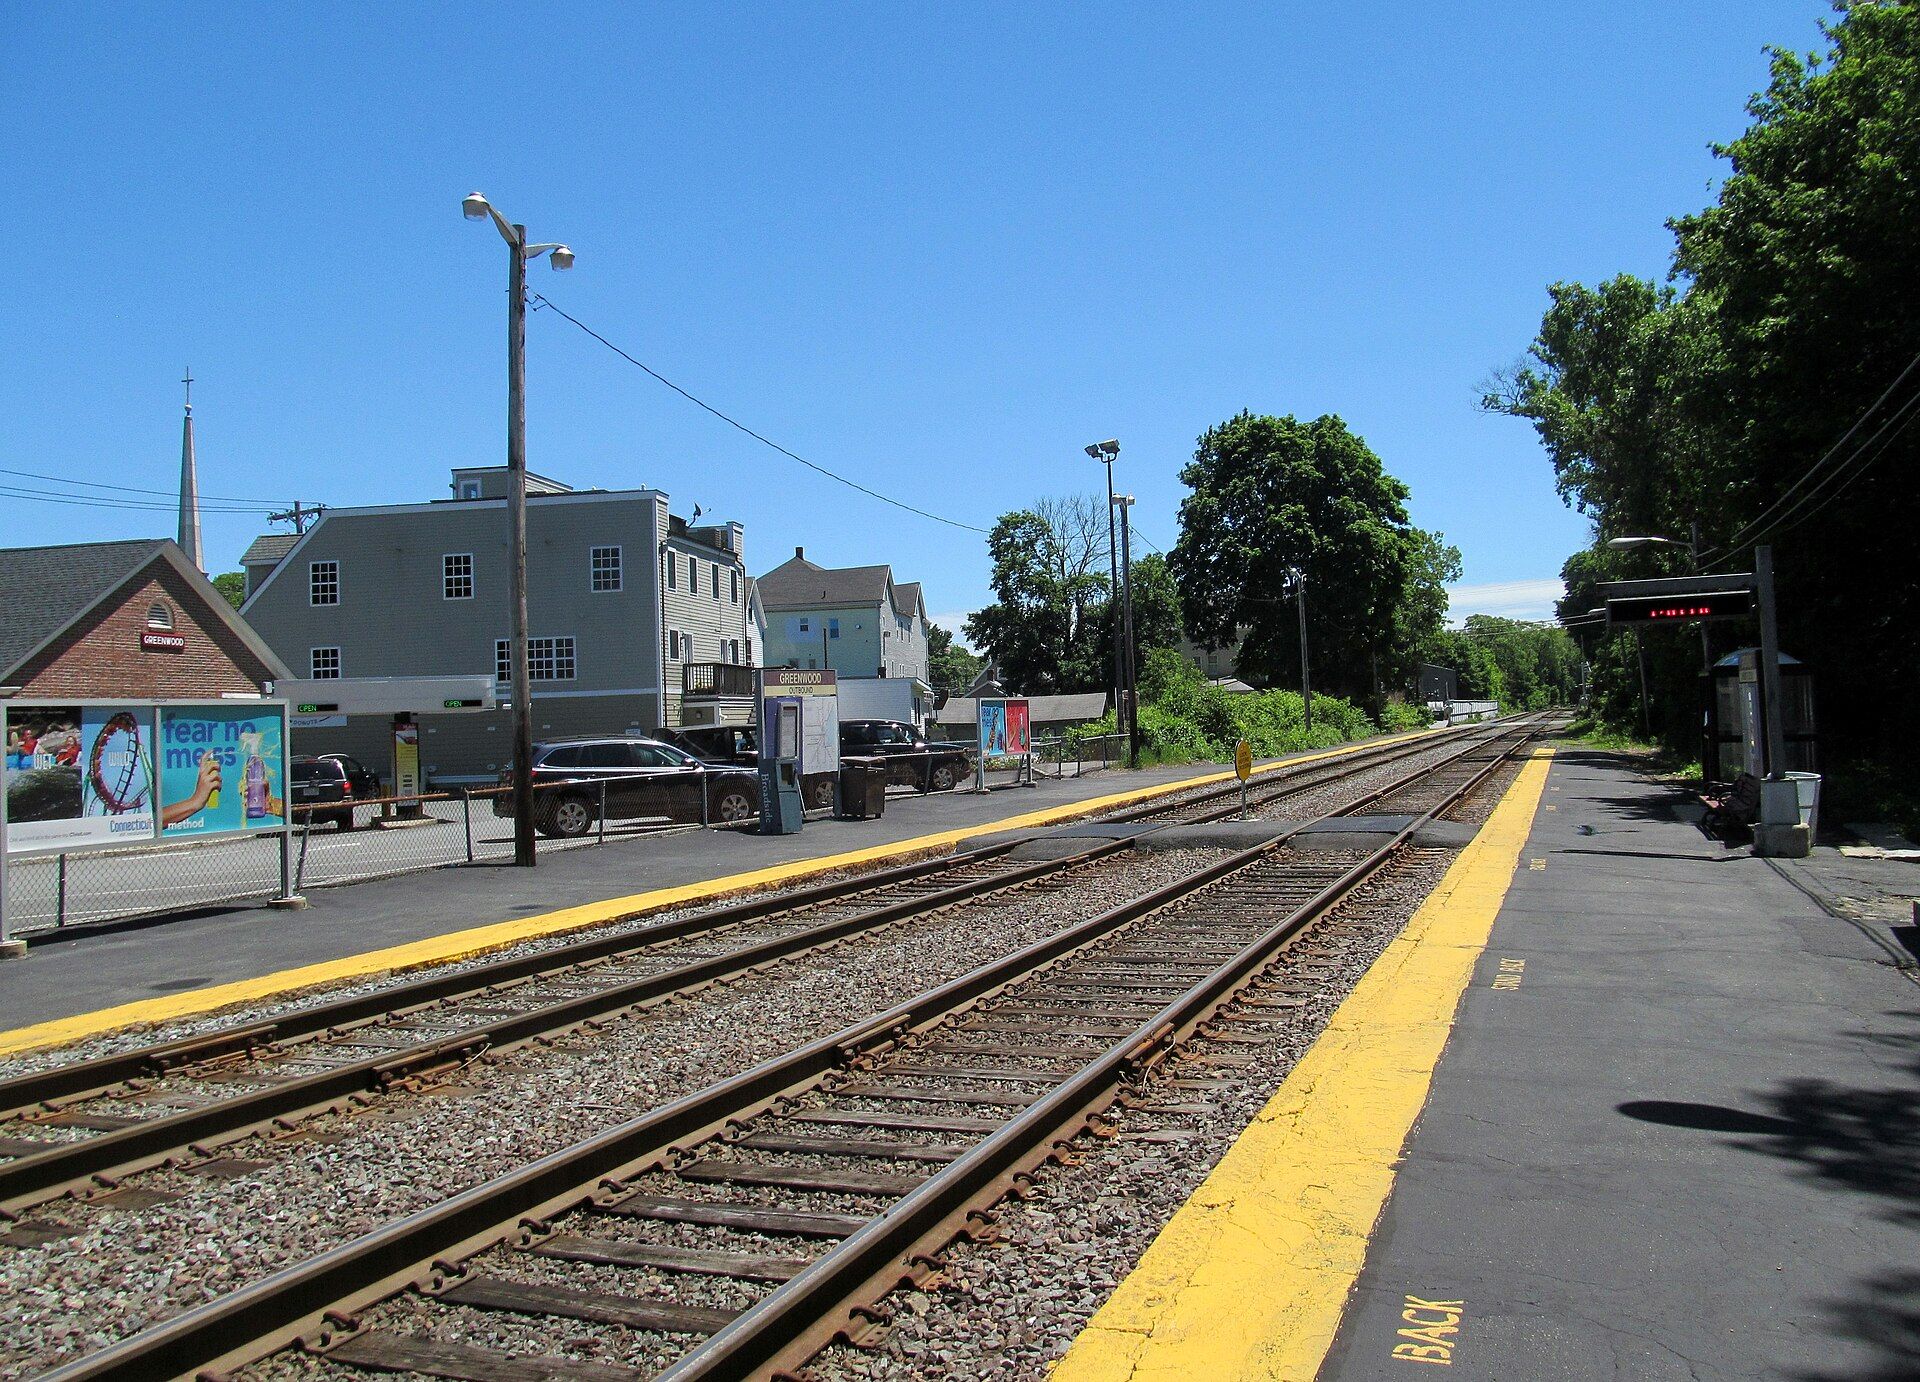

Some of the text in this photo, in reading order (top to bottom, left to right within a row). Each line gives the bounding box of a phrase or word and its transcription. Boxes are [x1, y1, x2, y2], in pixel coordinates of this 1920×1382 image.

[143, 635, 184, 646] GREENWOOD
[779, 672, 822, 684] GREENWOOD
[788, 686, 814, 694] OUTBOUND
[163, 712, 218, 743] fear
[166, 746, 237, 769] mess
[760, 773, 772, 823] Broadside
[110, 818, 153, 832] Connecticut
[167, 817, 205, 830] method
[1391, 1294, 1465, 1365] BACK
